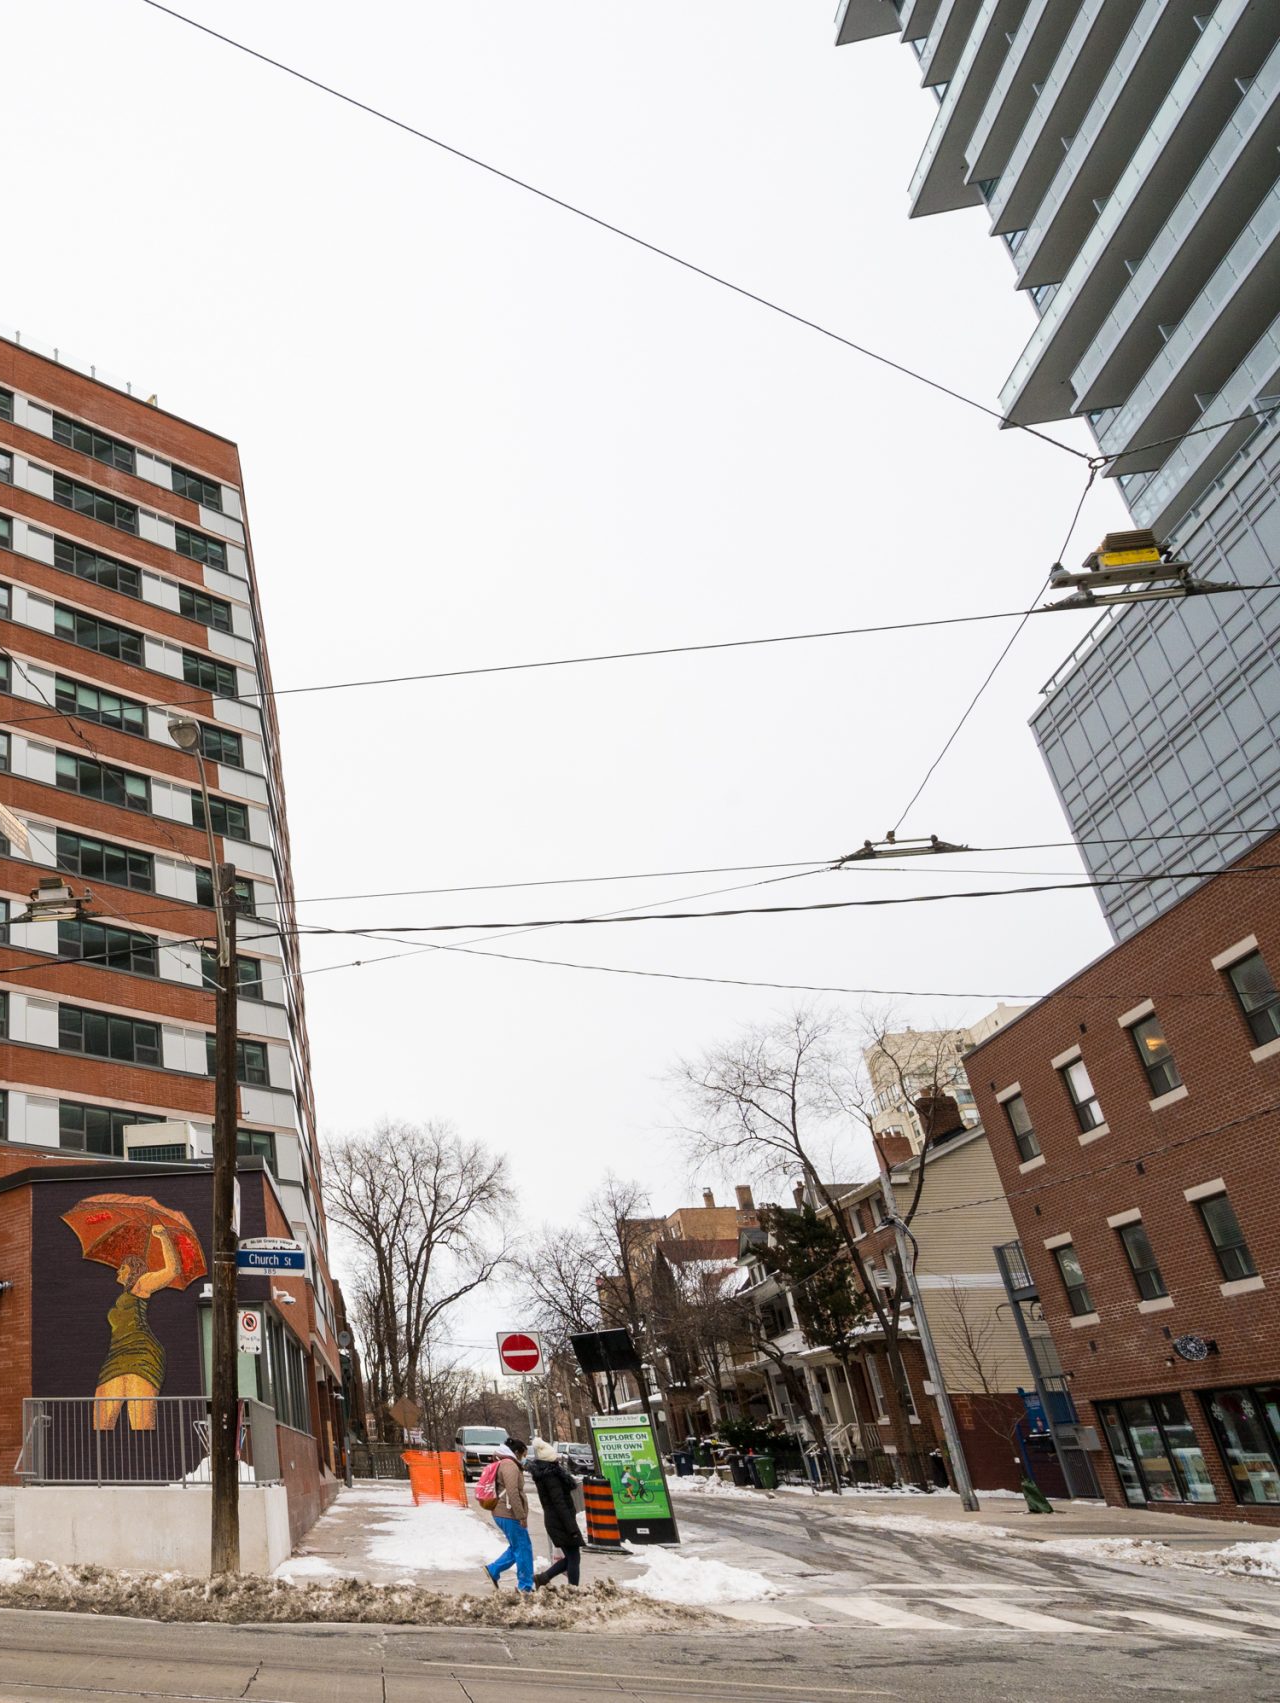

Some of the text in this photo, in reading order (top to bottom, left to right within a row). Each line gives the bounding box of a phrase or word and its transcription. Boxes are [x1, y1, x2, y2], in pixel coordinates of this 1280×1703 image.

[248, 1253, 292, 1266] Church St
[599, 1433, 634, 1442] EXPLORE
[601, 1443, 622, 1451] YOUR
[603, 1452, 631, 1460] TERMS
